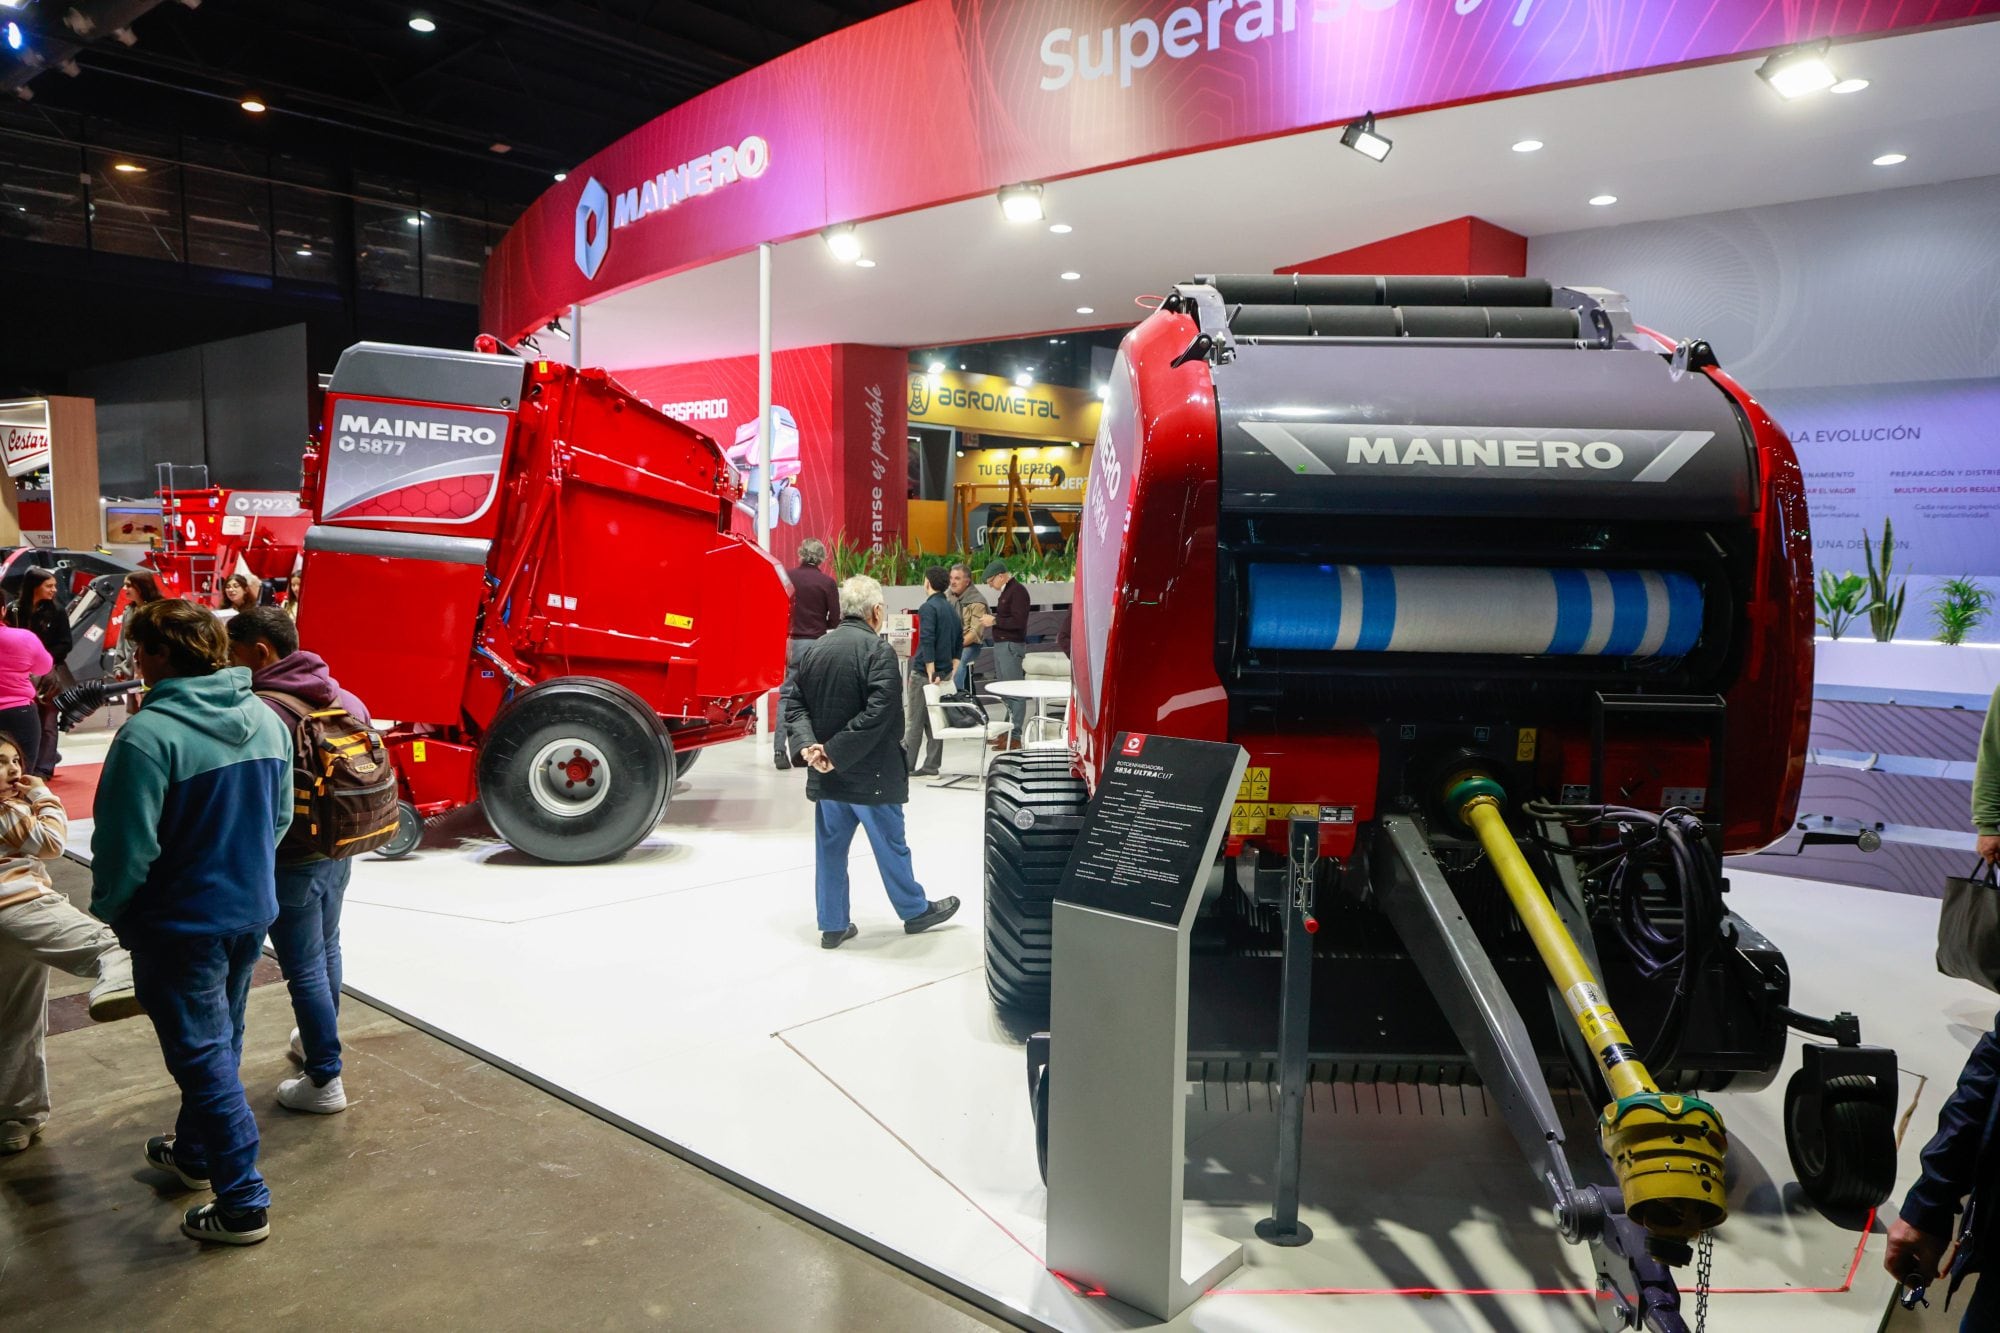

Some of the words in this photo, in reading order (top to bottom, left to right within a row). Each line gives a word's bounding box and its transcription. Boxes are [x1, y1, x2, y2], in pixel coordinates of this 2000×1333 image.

[613, 136, 768, 229] MAINERO
[662, 399, 728, 421] GASPARDO
[340, 414, 497, 446] MAINERO
[864, 384, 889, 461] posible
[1816, 425, 1921, 443] EVOLUCIÓN
[359, 438, 406, 456] 5877
[1346, 436, 1624, 470] MAINERO
[978, 464, 993, 476] TU
[252, 498, 293, 511] 2923
[1816, 539, 1845, 549] UNA
[1133, 769, 1174, 780] ULTRACUT
